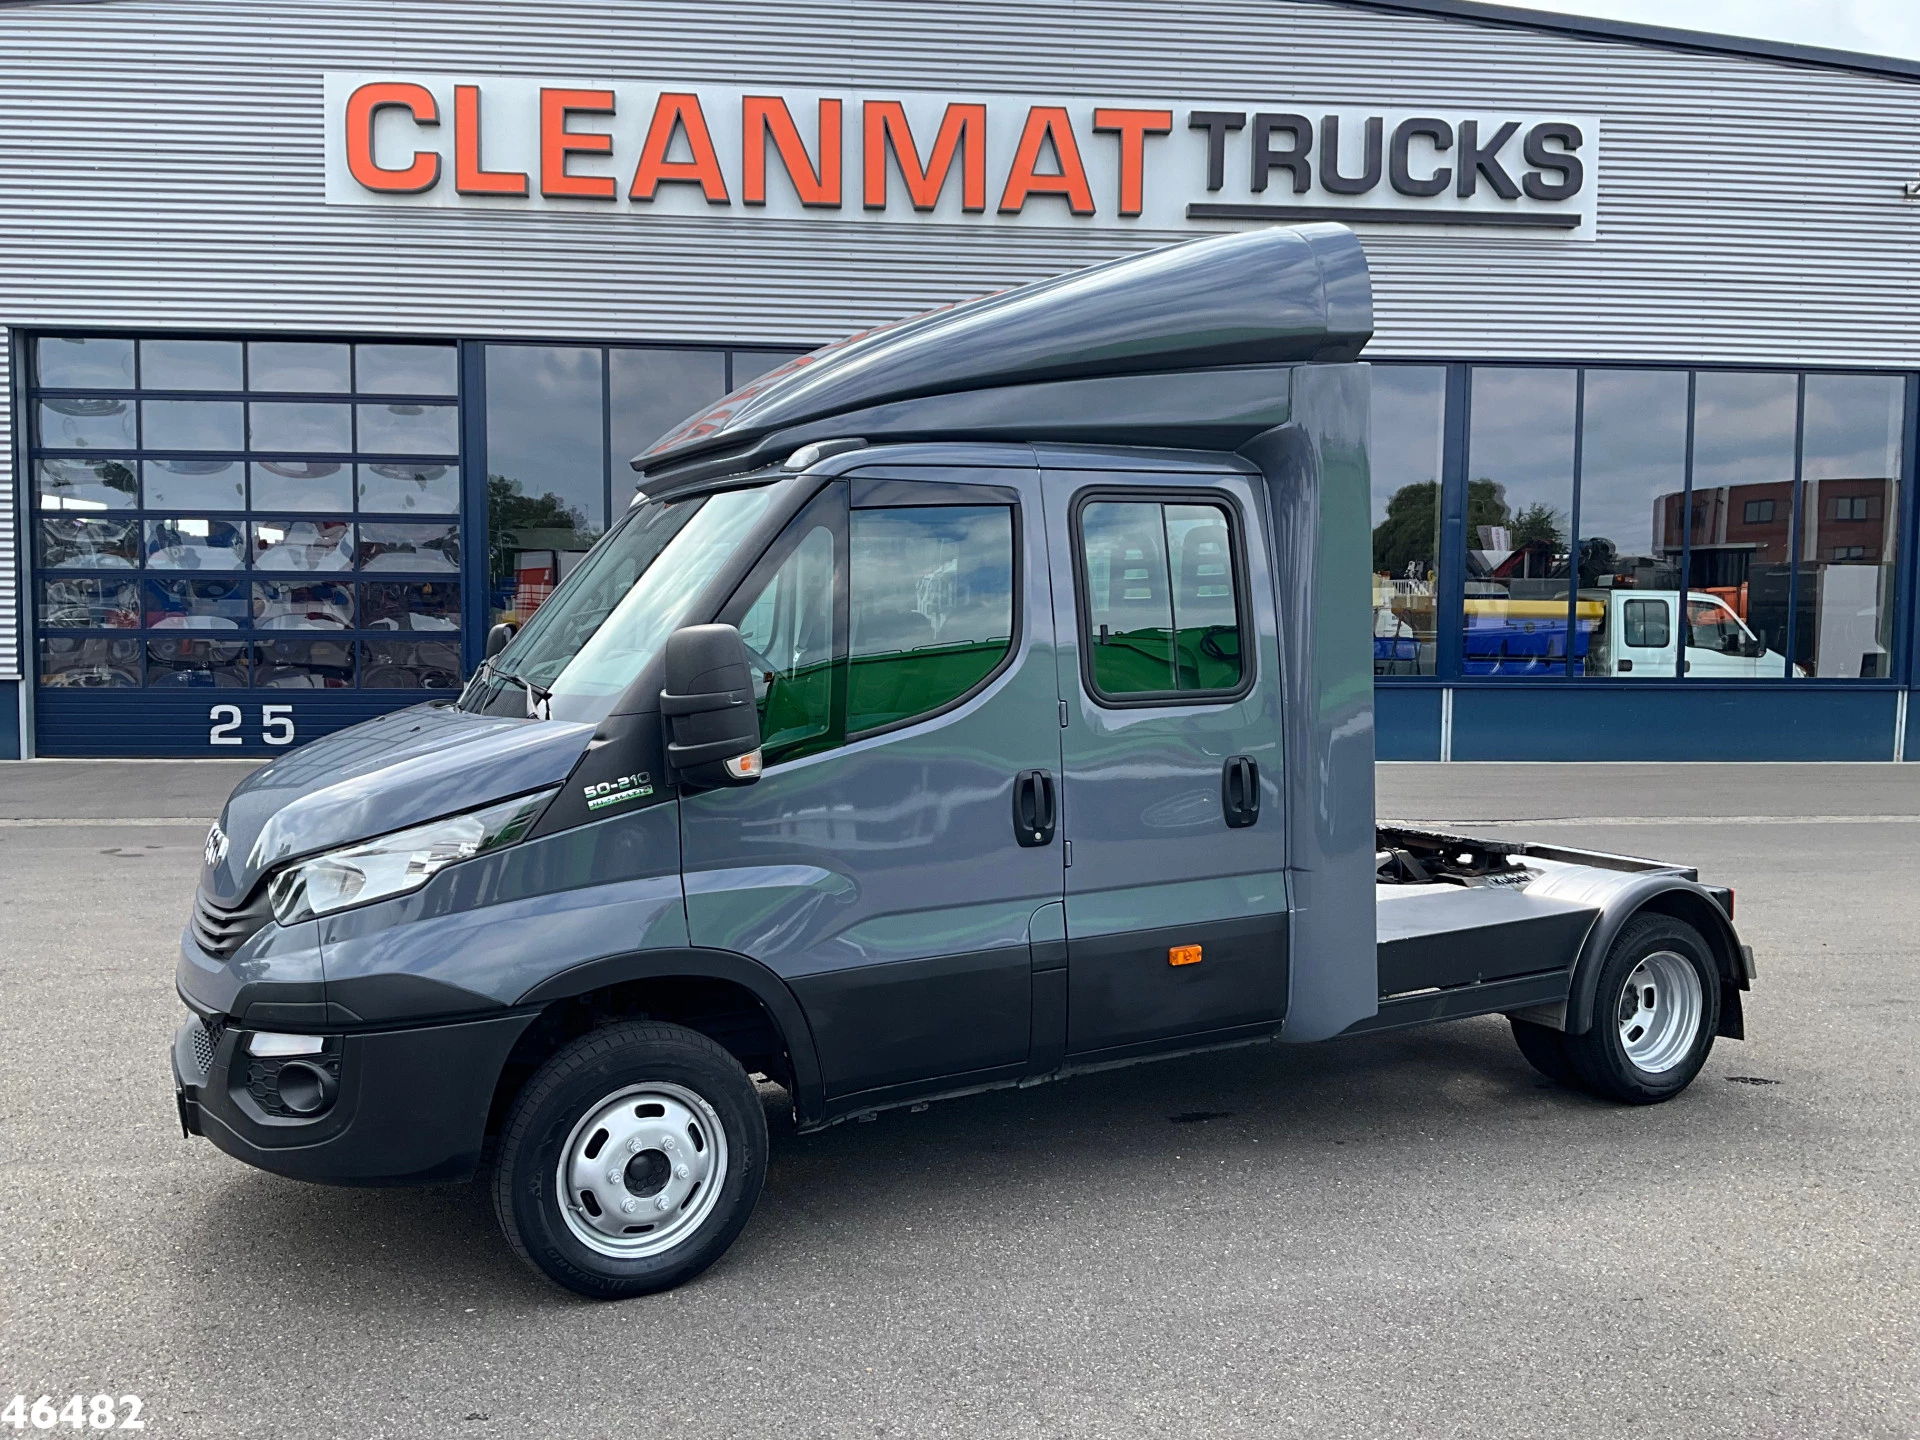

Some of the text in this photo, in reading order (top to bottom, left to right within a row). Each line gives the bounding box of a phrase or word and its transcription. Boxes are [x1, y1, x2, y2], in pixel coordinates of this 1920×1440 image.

[345, 82, 1584, 218] CLEANMAT TRUCKS
[583, 771, 651, 799] 50-210
